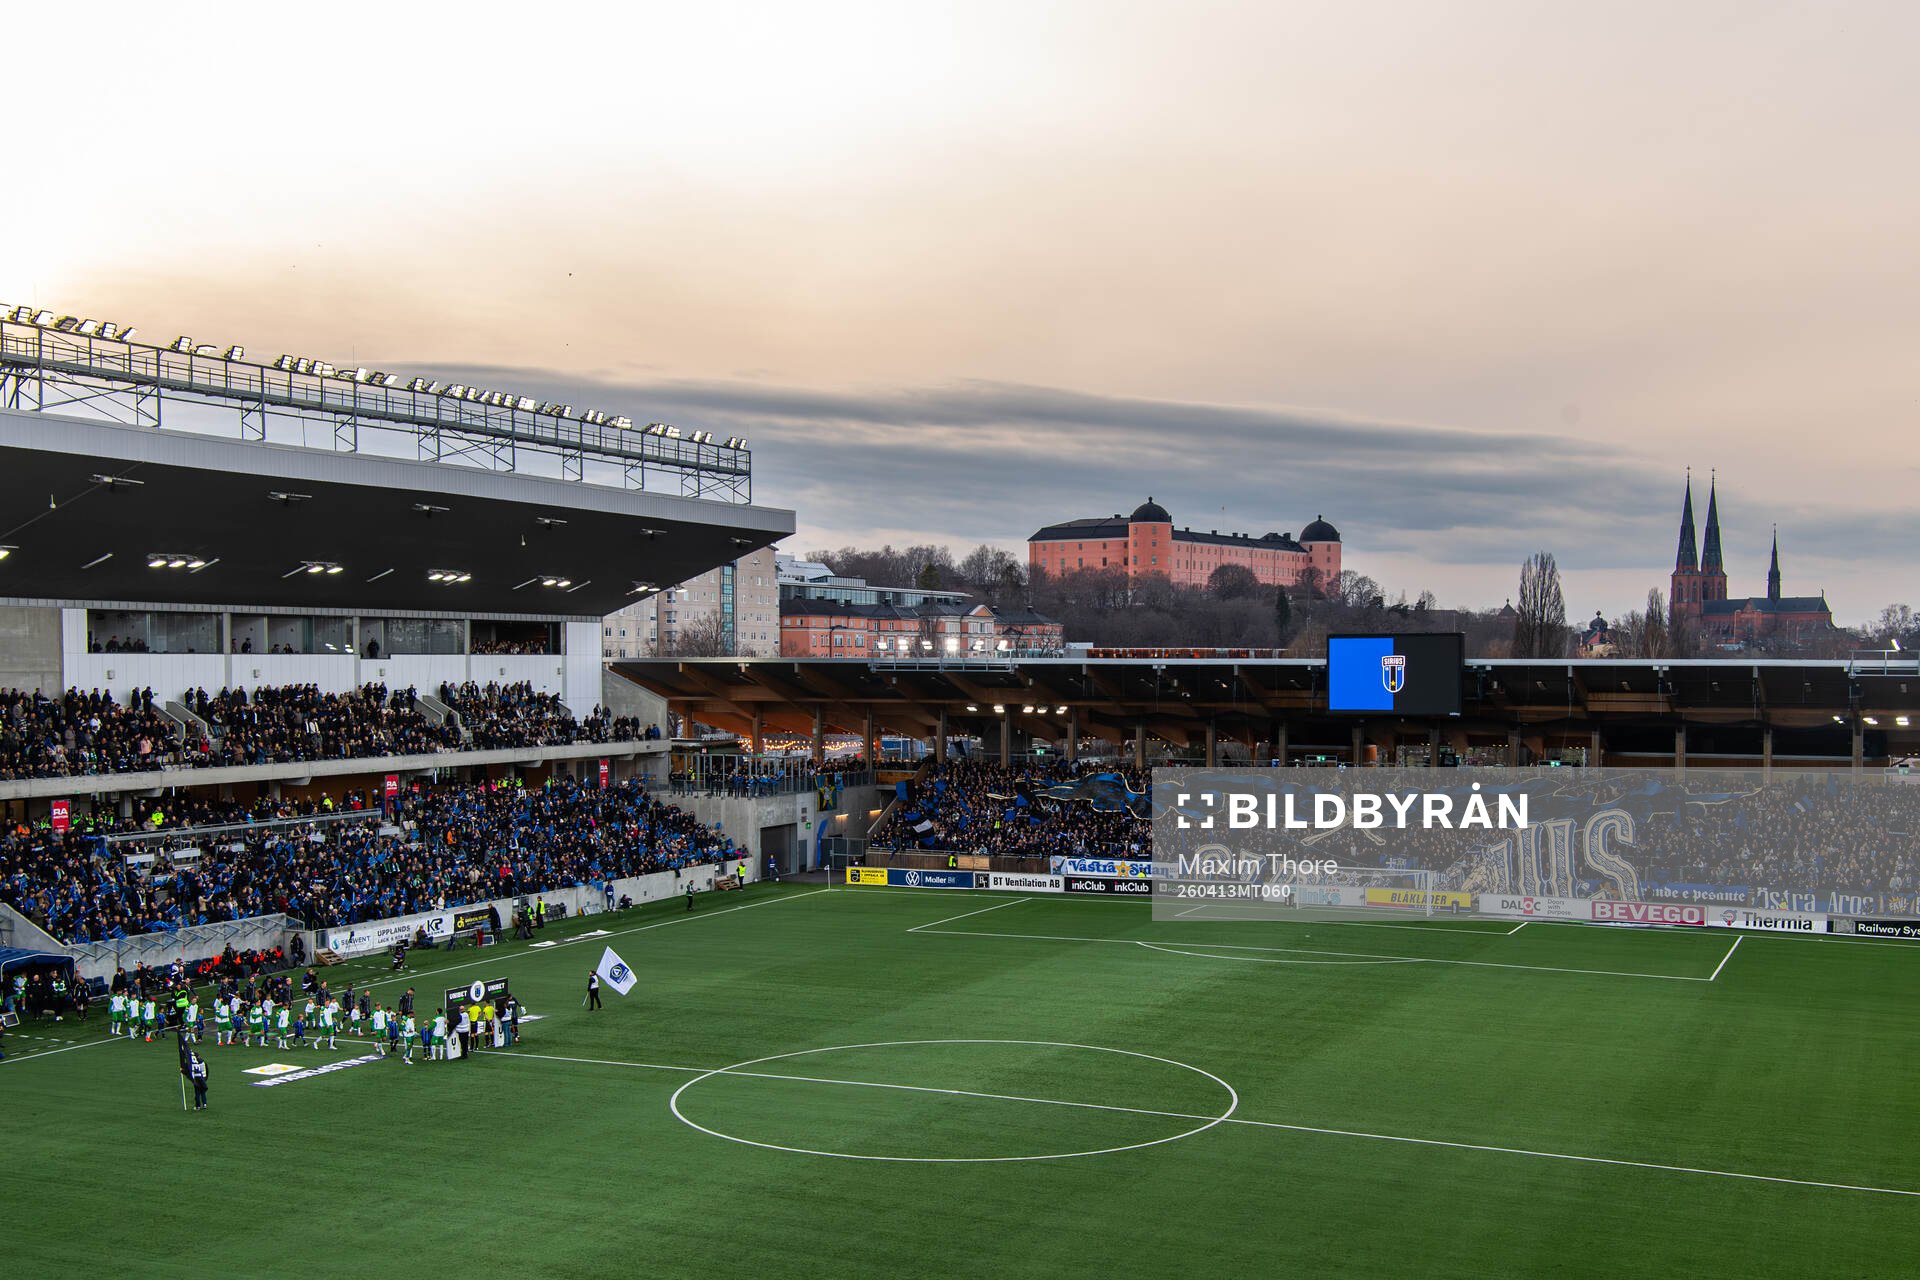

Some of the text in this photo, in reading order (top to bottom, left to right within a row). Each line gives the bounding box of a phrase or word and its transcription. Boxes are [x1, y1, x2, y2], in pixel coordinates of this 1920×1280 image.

[1384, 657, 1403, 665] SIRIUS
[1068, 859, 1116, 874] Västra
[993, 877, 1061, 889] BT Ventilation AB
[1071, 880, 1106, 891] inkClub
[1114, 881, 1149, 892] inkClub
[1692, 889, 1746, 902] pesante
[1501, 898, 1541, 913] DALOC
[1595, 902, 1700, 923] BEVEGO
[1742, 911, 1813, 931] Thermia
[377, 924, 411, 937] UPPLANDS
[1858, 923, 1901, 936] Railway
